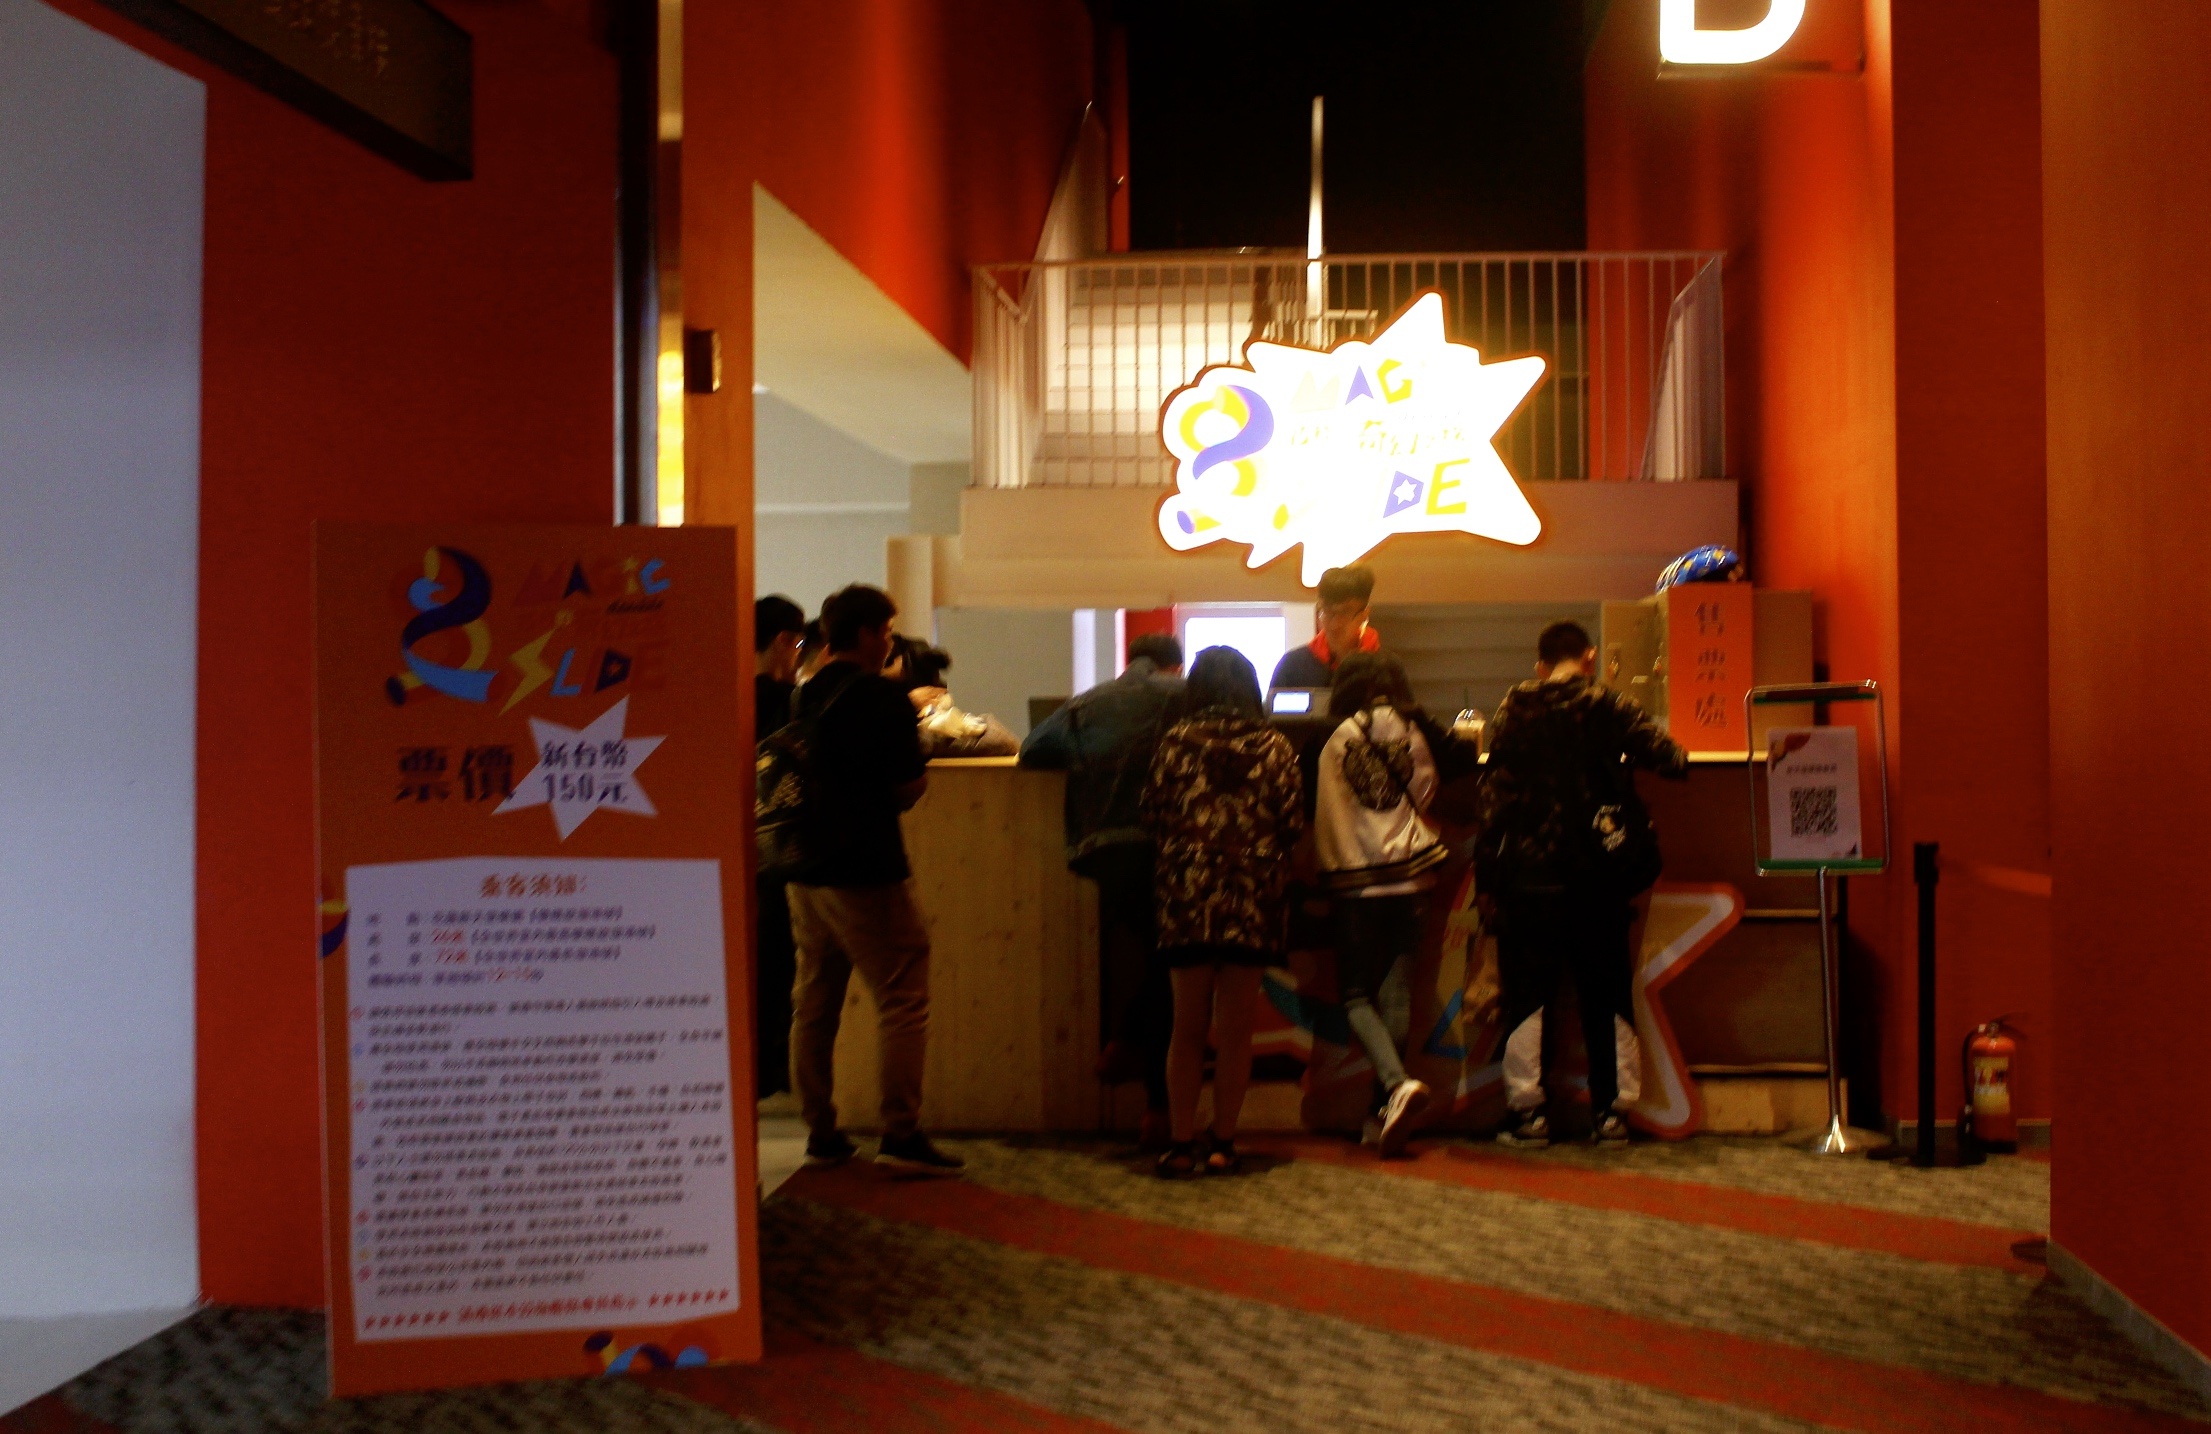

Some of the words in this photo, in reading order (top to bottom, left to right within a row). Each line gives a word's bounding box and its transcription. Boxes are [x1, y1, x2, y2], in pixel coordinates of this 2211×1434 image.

[541, 740, 629, 770] 新台幣
[395, 744, 517, 802] 票價
[542, 772, 629, 803] 150元
